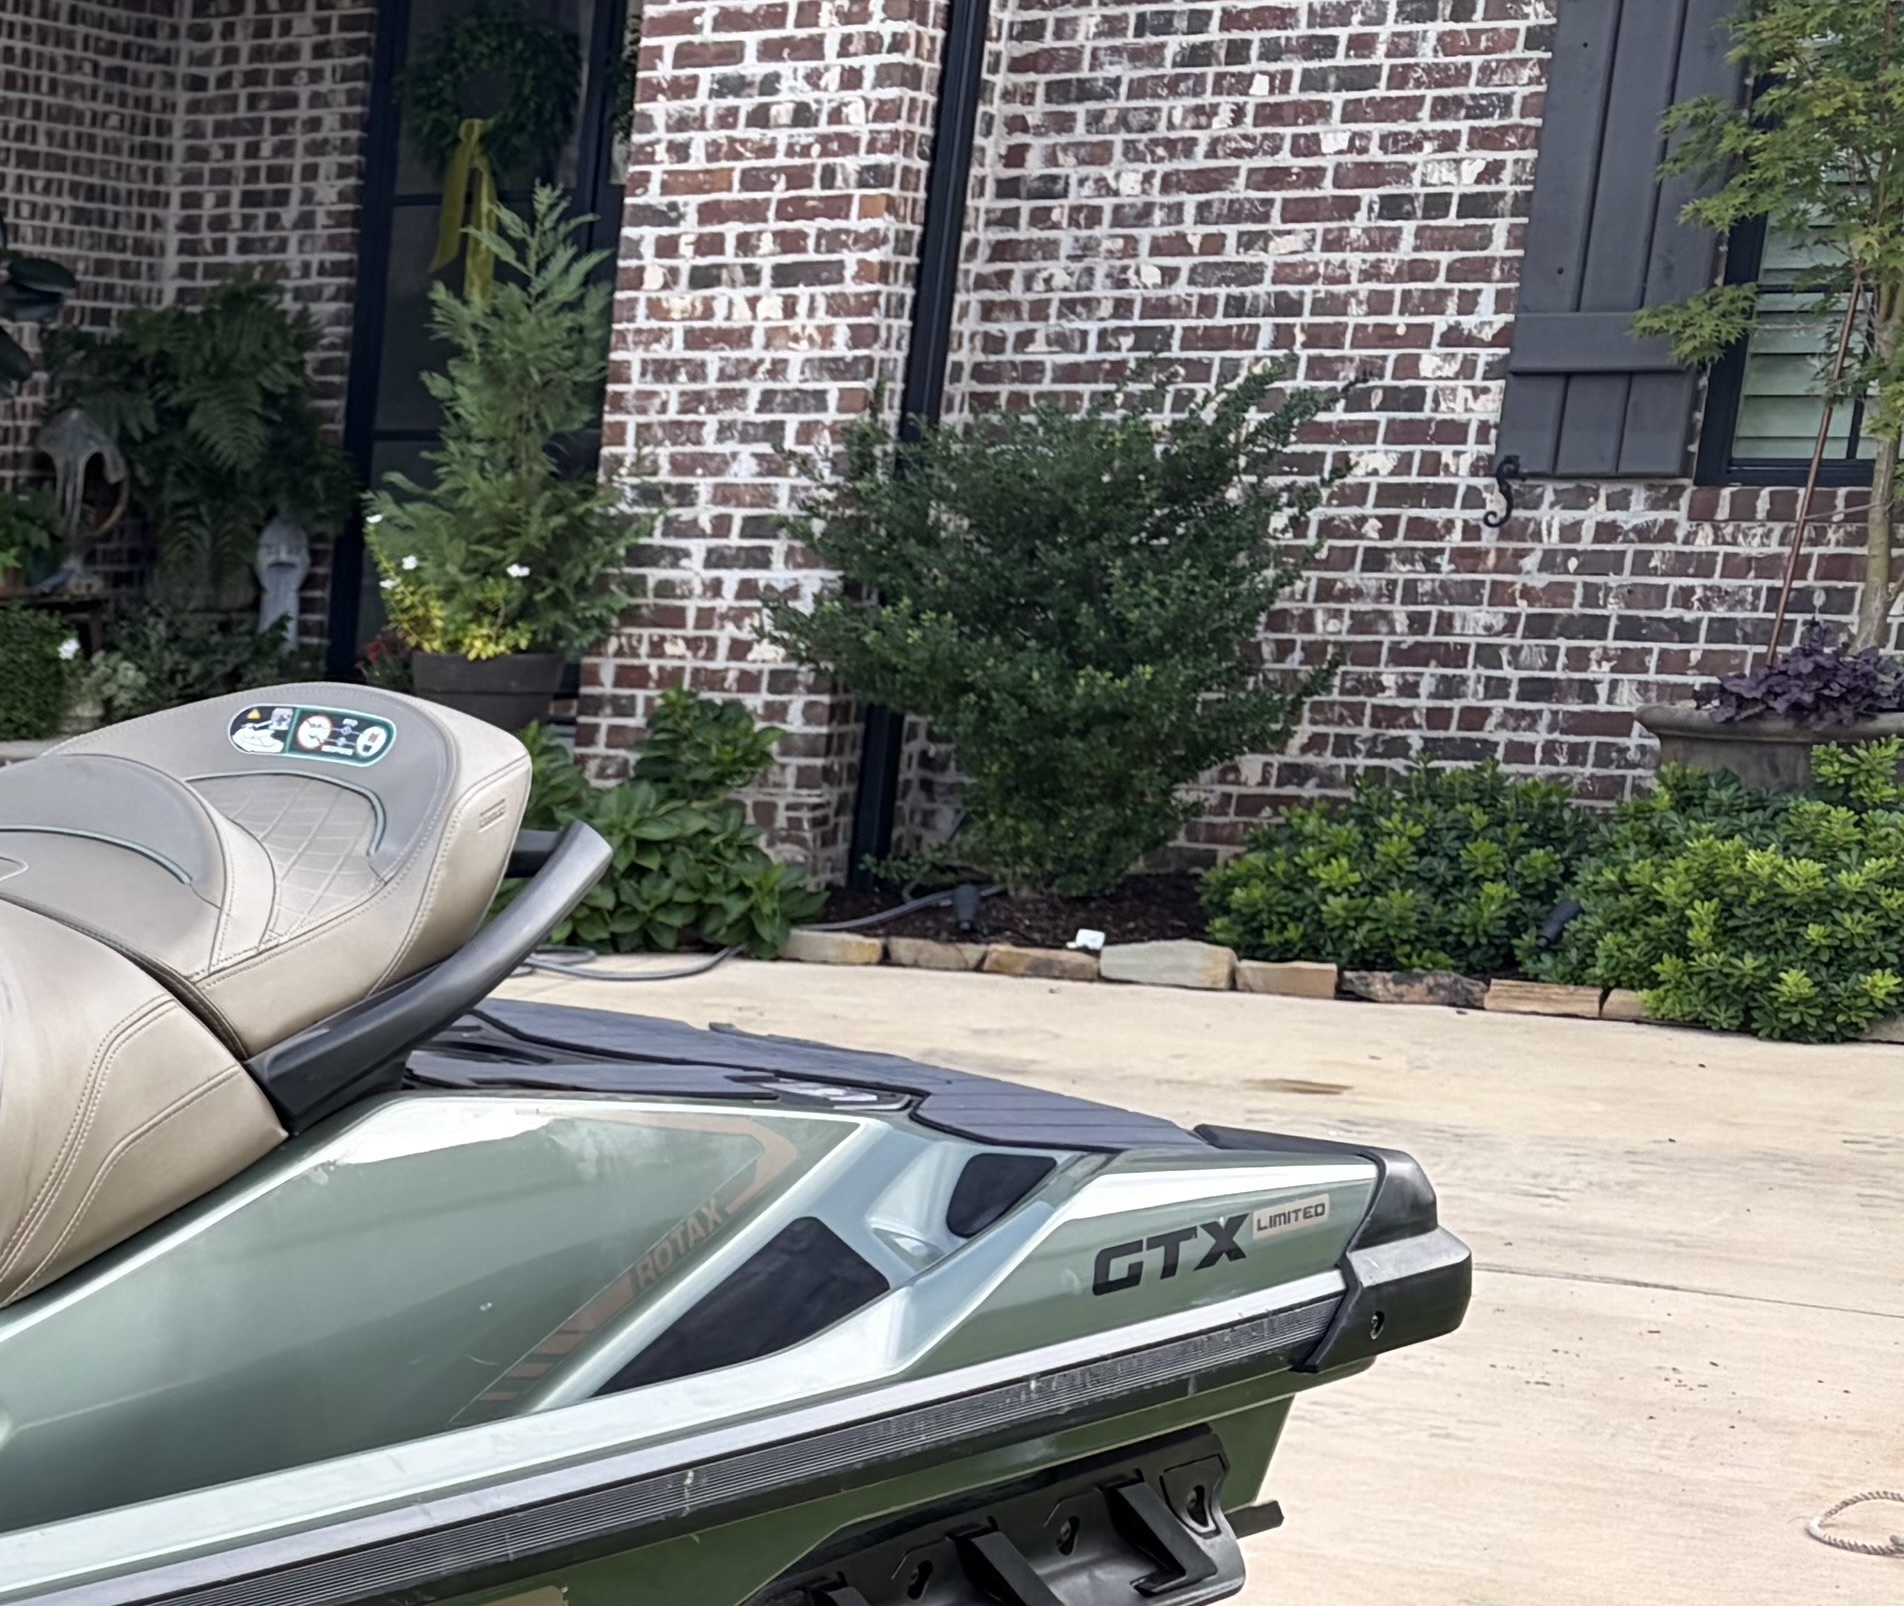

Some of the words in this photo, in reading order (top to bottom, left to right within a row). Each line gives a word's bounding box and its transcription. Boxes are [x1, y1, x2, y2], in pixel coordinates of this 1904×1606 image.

[633, 1199, 729, 1293] ROTAX
[1093, 1213, 1250, 1296] GTX
[1256, 1202, 1325, 1231] LIMITED
